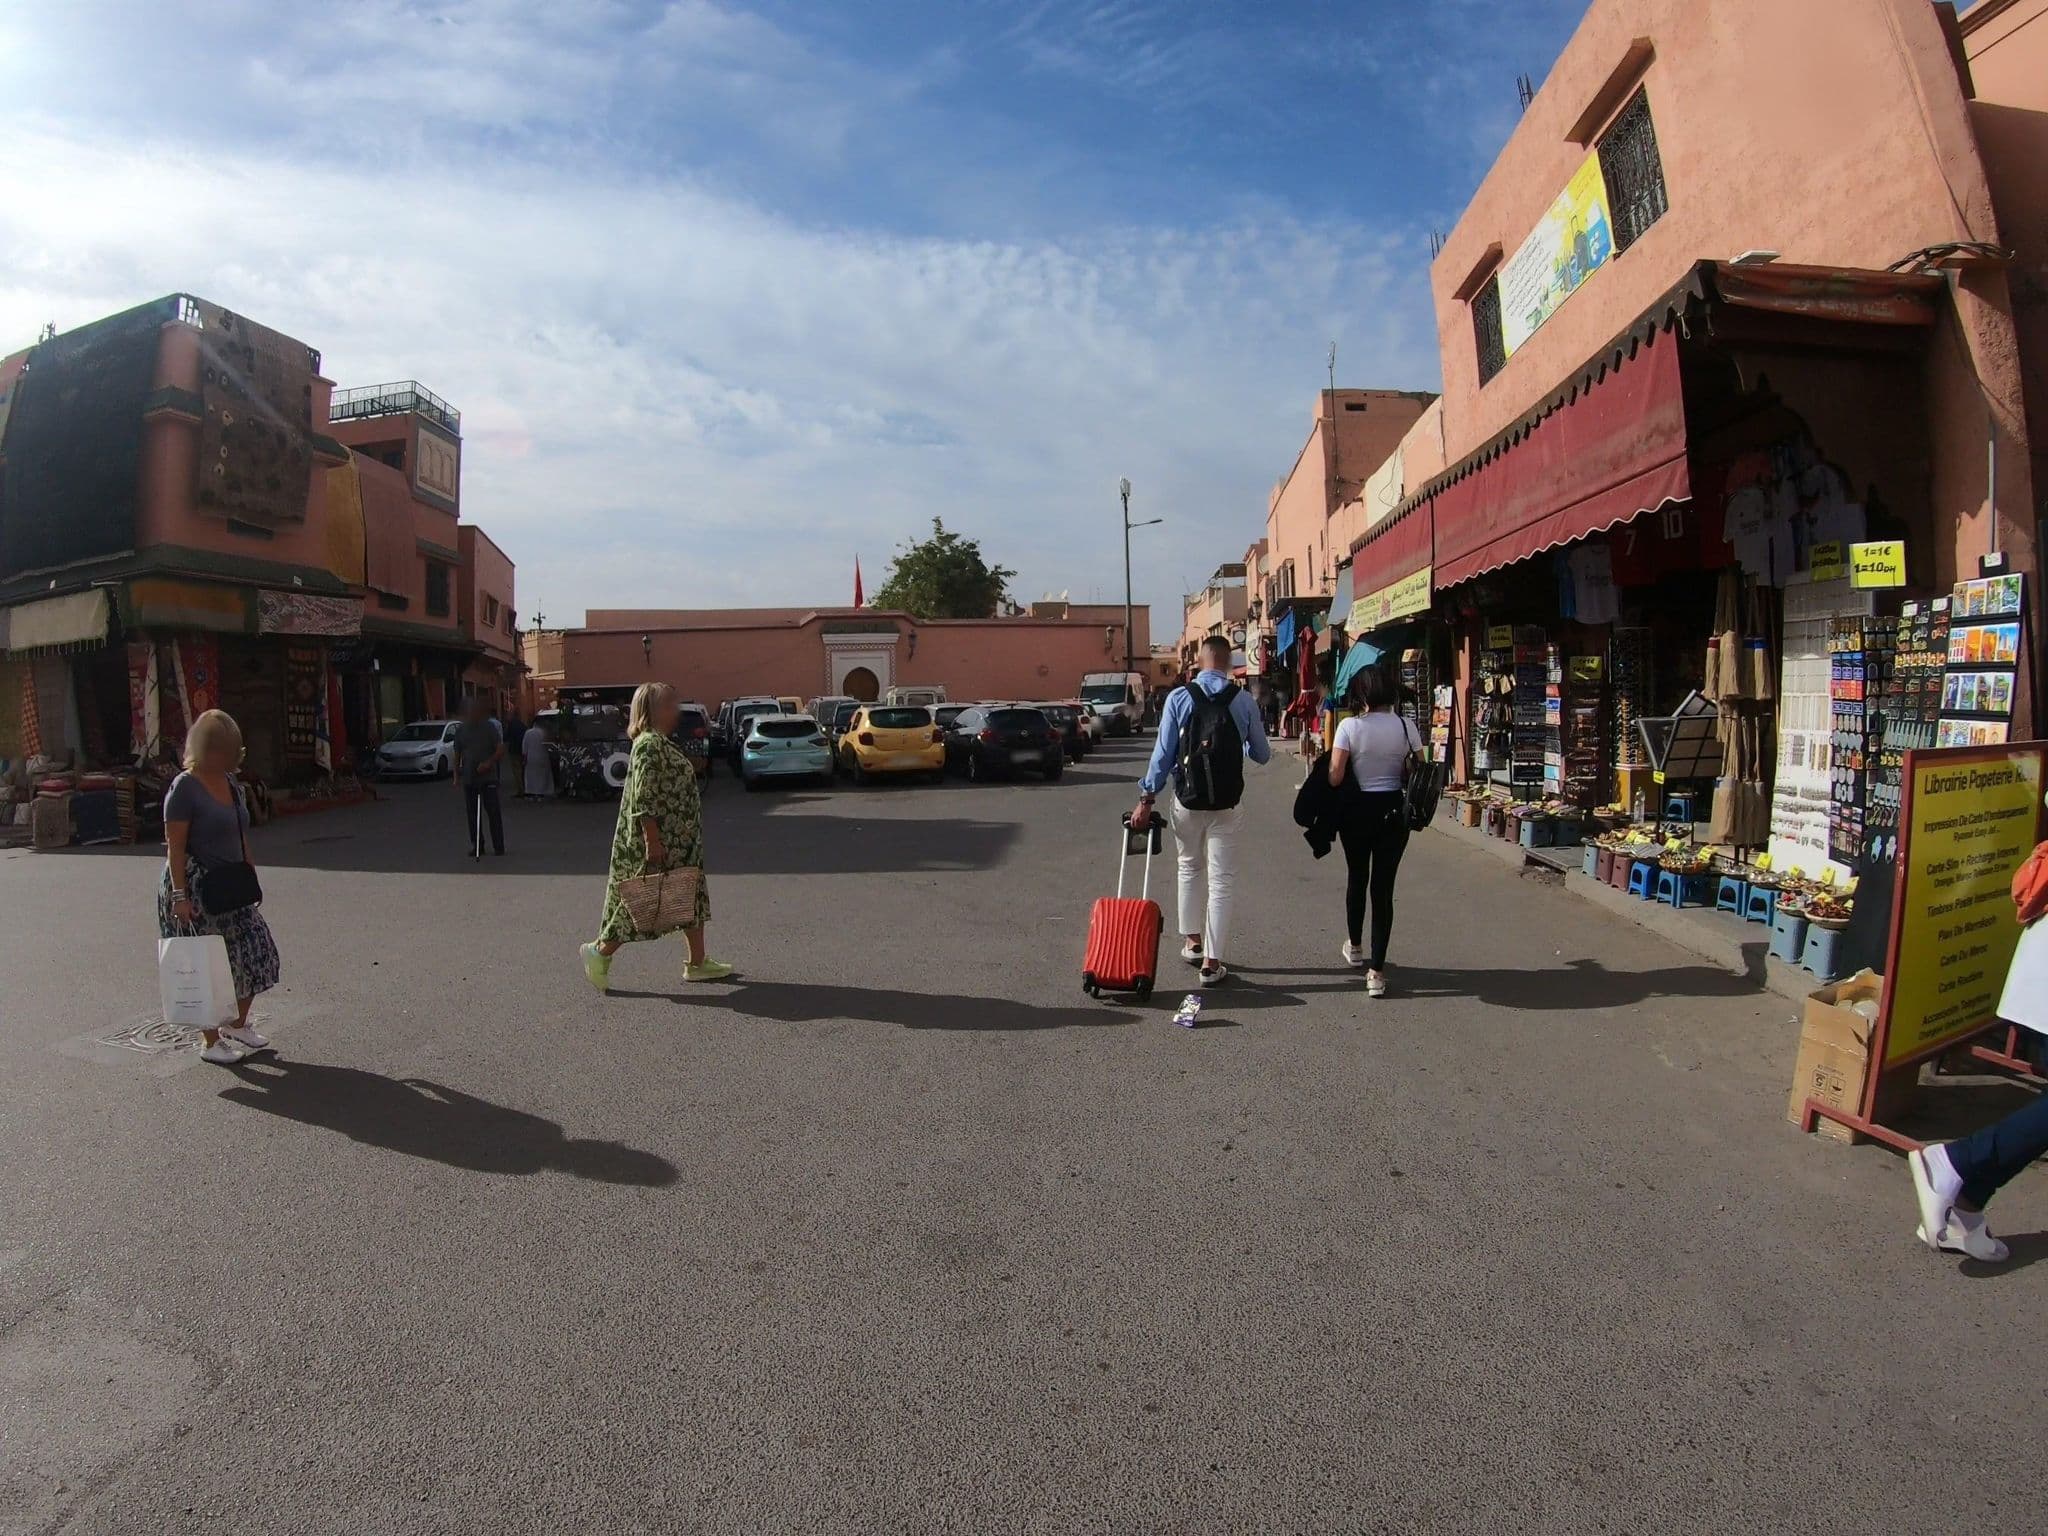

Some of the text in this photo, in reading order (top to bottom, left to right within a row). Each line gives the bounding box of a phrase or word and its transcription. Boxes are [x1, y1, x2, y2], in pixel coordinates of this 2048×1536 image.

[1863, 546, 1892, 557] 1=1€
[1854, 562, 1897, 573] 1=10DH
[1924, 771, 1968, 795] Librairie
[1969, 767, 2013, 792] Papeterie
[1959, 815, 1968, 827] De
